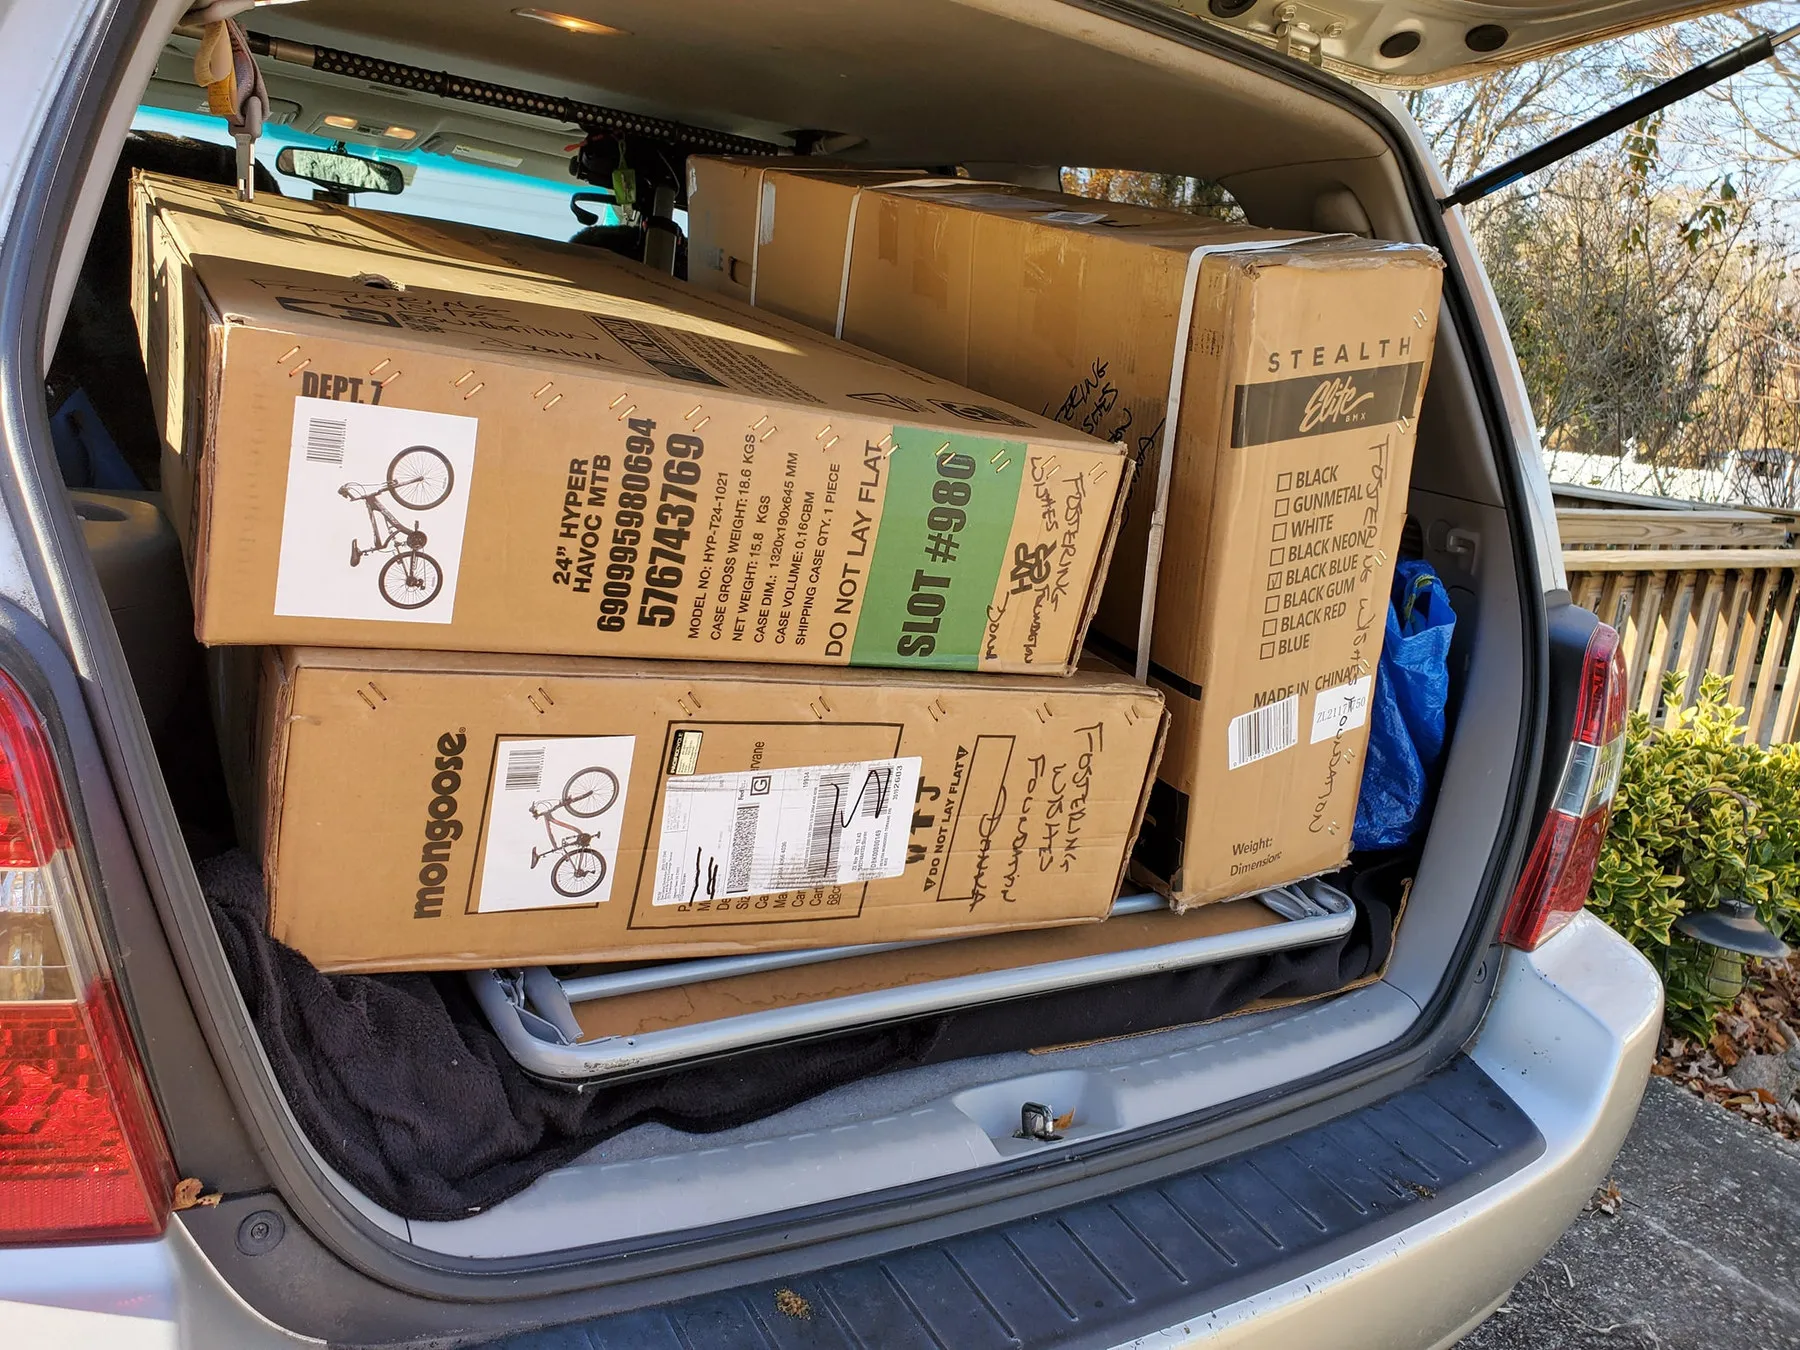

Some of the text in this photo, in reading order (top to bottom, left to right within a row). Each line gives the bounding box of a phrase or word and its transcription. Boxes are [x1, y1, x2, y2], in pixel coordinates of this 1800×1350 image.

[1267, 336, 1411, 373] STEALTH
[1298, 376, 1374, 433] Elite
[1345, 412, 1367, 423] BMX
[742, 434, 755, 464] KGS
[1295, 464, 1339, 489] BLACK
[559, 458, 589, 539] HYPER
[756, 495, 770, 523] KGS
[1293, 483, 1363, 514] GUNMETAL
[573, 454, 611, 593] HAVOC MTB
[597, 418, 657, 633] 690995980694
[637, 433, 705, 628] 576743769
[1051, 472, 1086, 612] FOSTERING
[1291, 514, 1334, 538] WHITE
[688, 472, 728, 639] MODEL NO: HYP-T24-1021
[749, 533, 764, 557] 15.8
[754, 452, 798, 643] CASE DIM.: 1320x190x645 MM
[795, 587, 816, 645] SHIPPING
[809, 549, 825, 583] CASE
[817, 519, 831, 546] QTY.
[825, 463, 840, 503] PIECE
[825, 440, 883, 657] DO NOT LAY FLAT
[897, 452, 976, 657] SLOT #980
[1288, 528, 1366, 563] BLACK NEON
[718, 557, 736, 602] GROSS
[782, 551, 803, 608] VOLUME:
[1286, 554, 1358, 587] BLACK BLUE
[1283, 576, 1355, 610] BLACK GUM
[711, 606, 726, 640] CASE
[732, 617, 746, 641] NET
[775, 611, 790, 644] CASE
[1281, 601, 1347, 633] BLACK RED
[1278, 633, 1311, 656] BLUE
[1253, 669, 1352, 708] MADE IN CHINA
[1059, 721, 1104, 873] FOSTERING
[929, 761, 965, 876] DO NOT LAY FLAT
[1038, 763, 1067, 872] WISHES
[1232, 837, 1273, 856] Weight:
